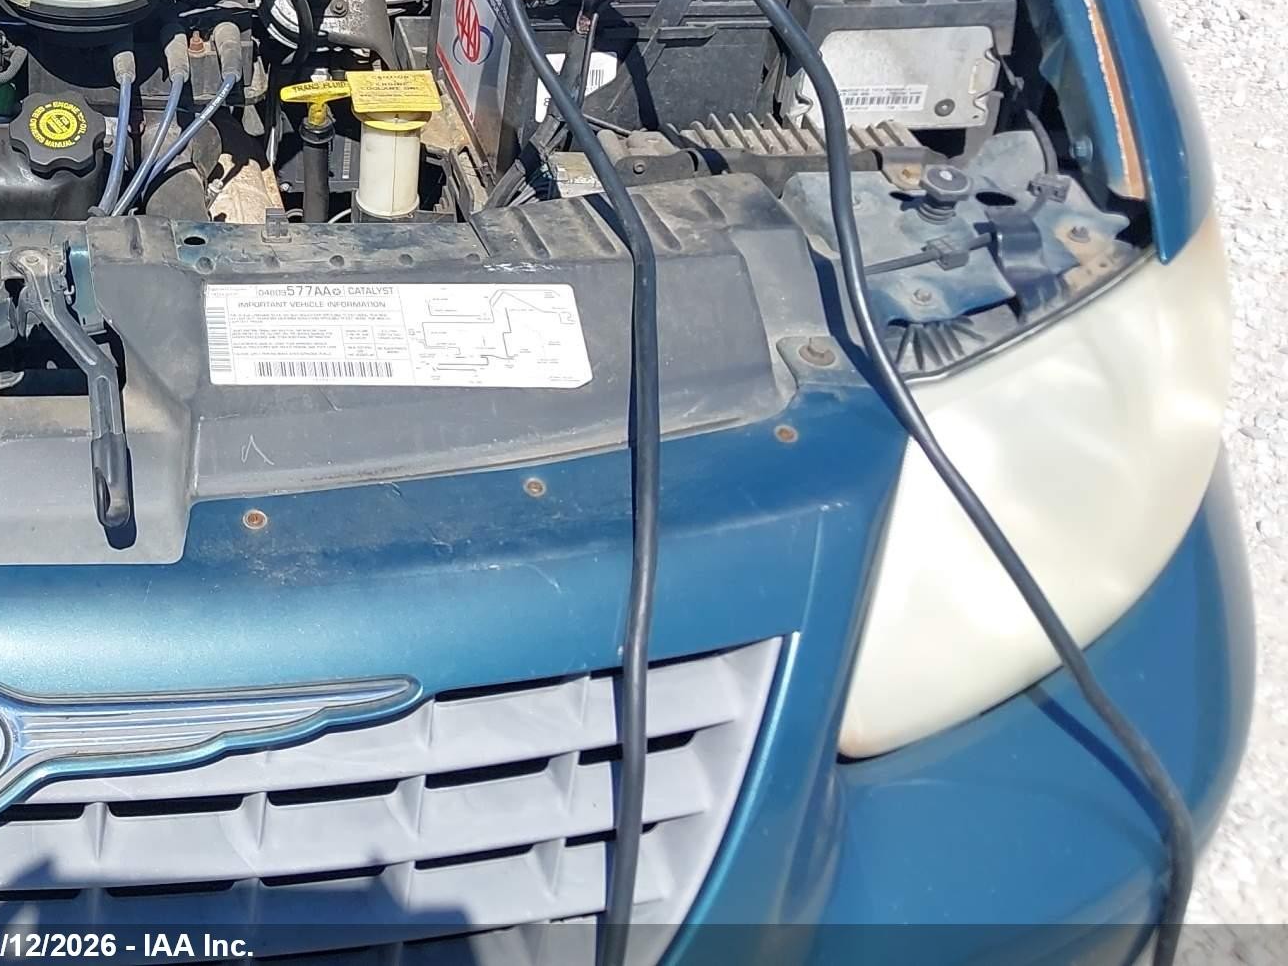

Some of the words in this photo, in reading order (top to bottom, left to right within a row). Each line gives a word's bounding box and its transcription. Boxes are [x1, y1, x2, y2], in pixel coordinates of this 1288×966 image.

[292, 83, 320, 92] TRANS
[322, 81, 347, 90] FLUID
[52, 101, 81, 115] ENGINE
[78, 123, 88, 135] OIL
[44, 139, 76, 148] MANUAL
[347, 286, 394, 296] CATALYST
